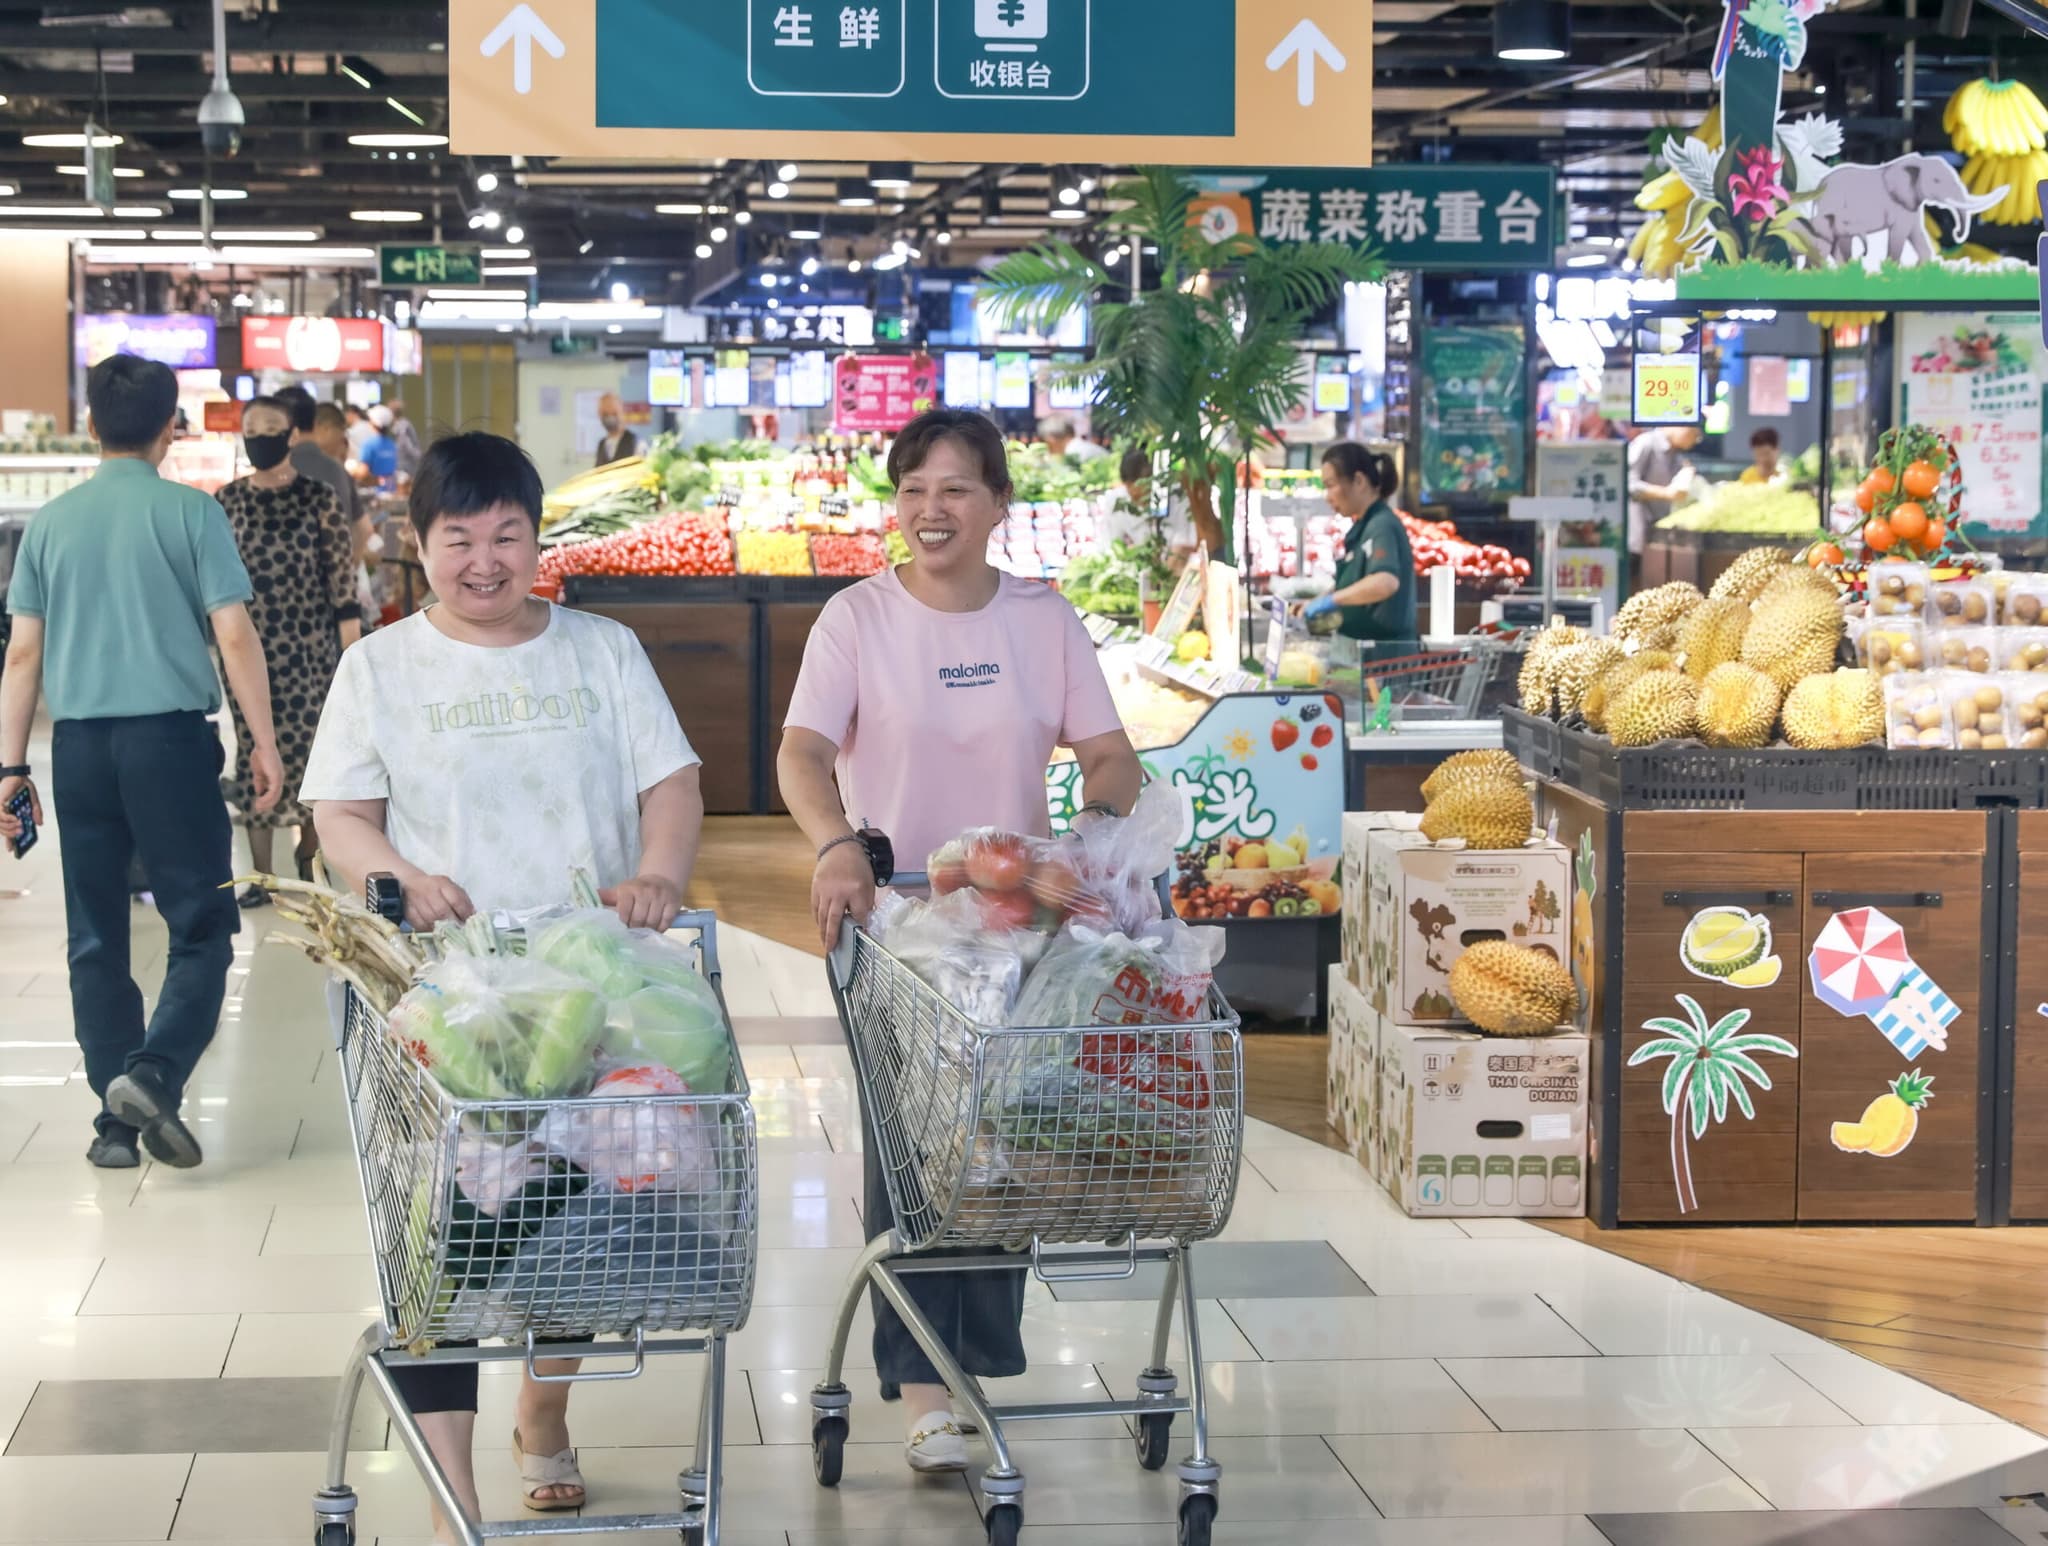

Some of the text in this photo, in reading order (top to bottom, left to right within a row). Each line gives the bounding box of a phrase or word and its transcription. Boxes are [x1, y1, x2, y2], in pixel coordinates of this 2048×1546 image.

[773, 5, 880, 50] 生鲜
[969, 59, 1052, 89] 收银台
[1259, 188, 1543, 244] 蔬菜称重台
[938, 662, 1000, 680] maloima
[1487, 1055, 1579, 1072] 泰国原
[1488, 1075, 1518, 1088] THAI
[1529, 1090, 1577, 1102] DURIAN
